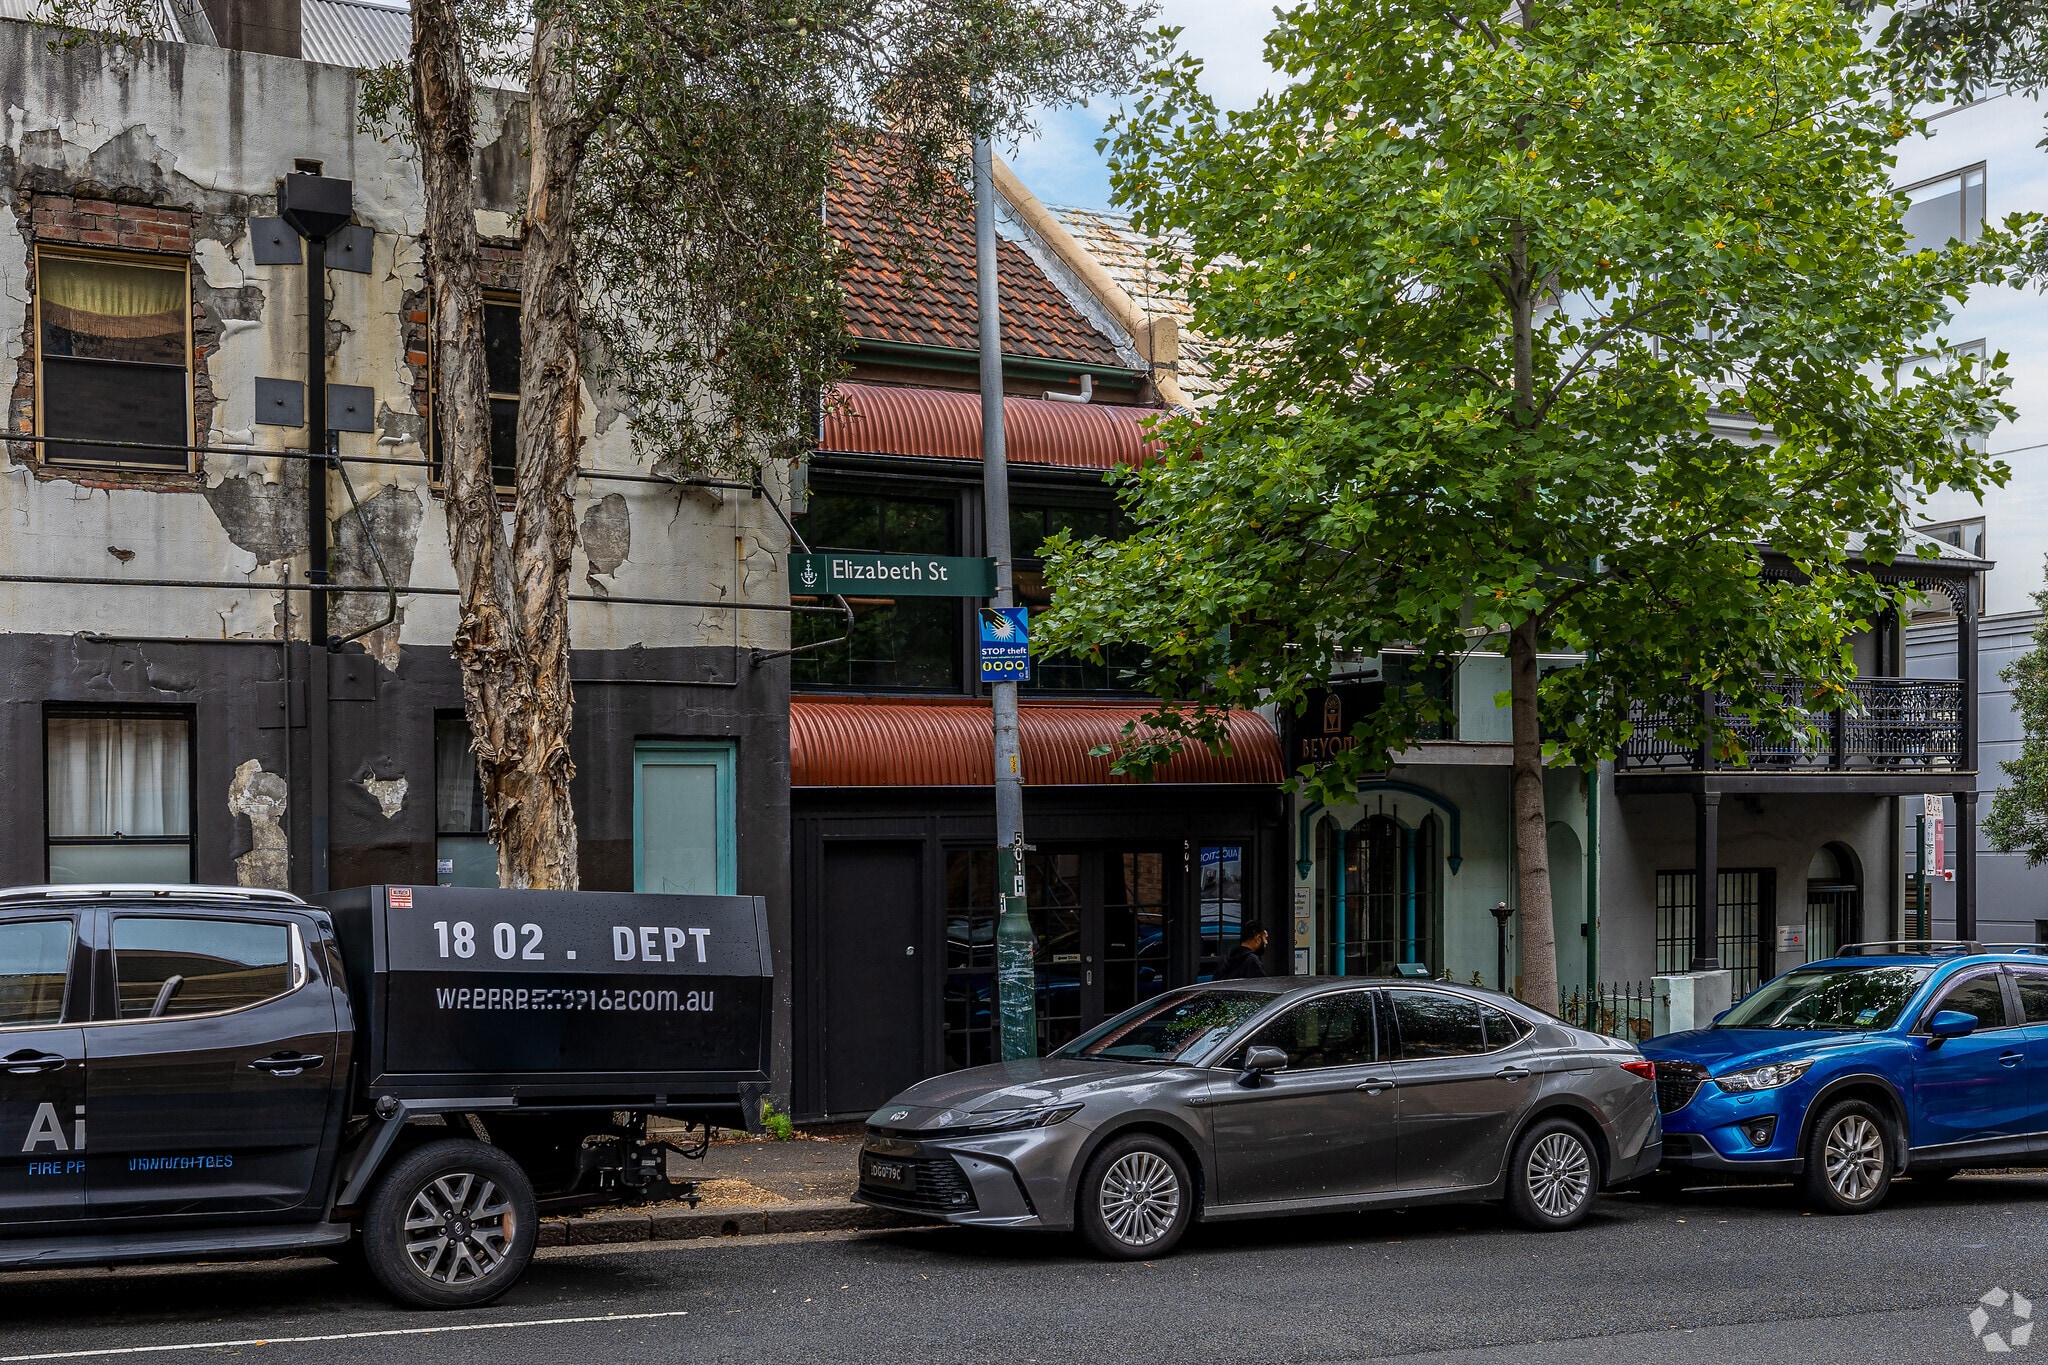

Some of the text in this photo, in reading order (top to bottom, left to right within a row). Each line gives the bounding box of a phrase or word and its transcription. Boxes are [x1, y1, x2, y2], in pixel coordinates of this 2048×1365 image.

[832, 559, 948, 581] Elizabeth St
[981, 646, 1027, 656] STOP theft
[433, 920, 476, 959] 18
[492, 922, 545, 960] 02
[612, 925, 711, 962] DEPT
[29, 1161, 62, 1176] FIRE
